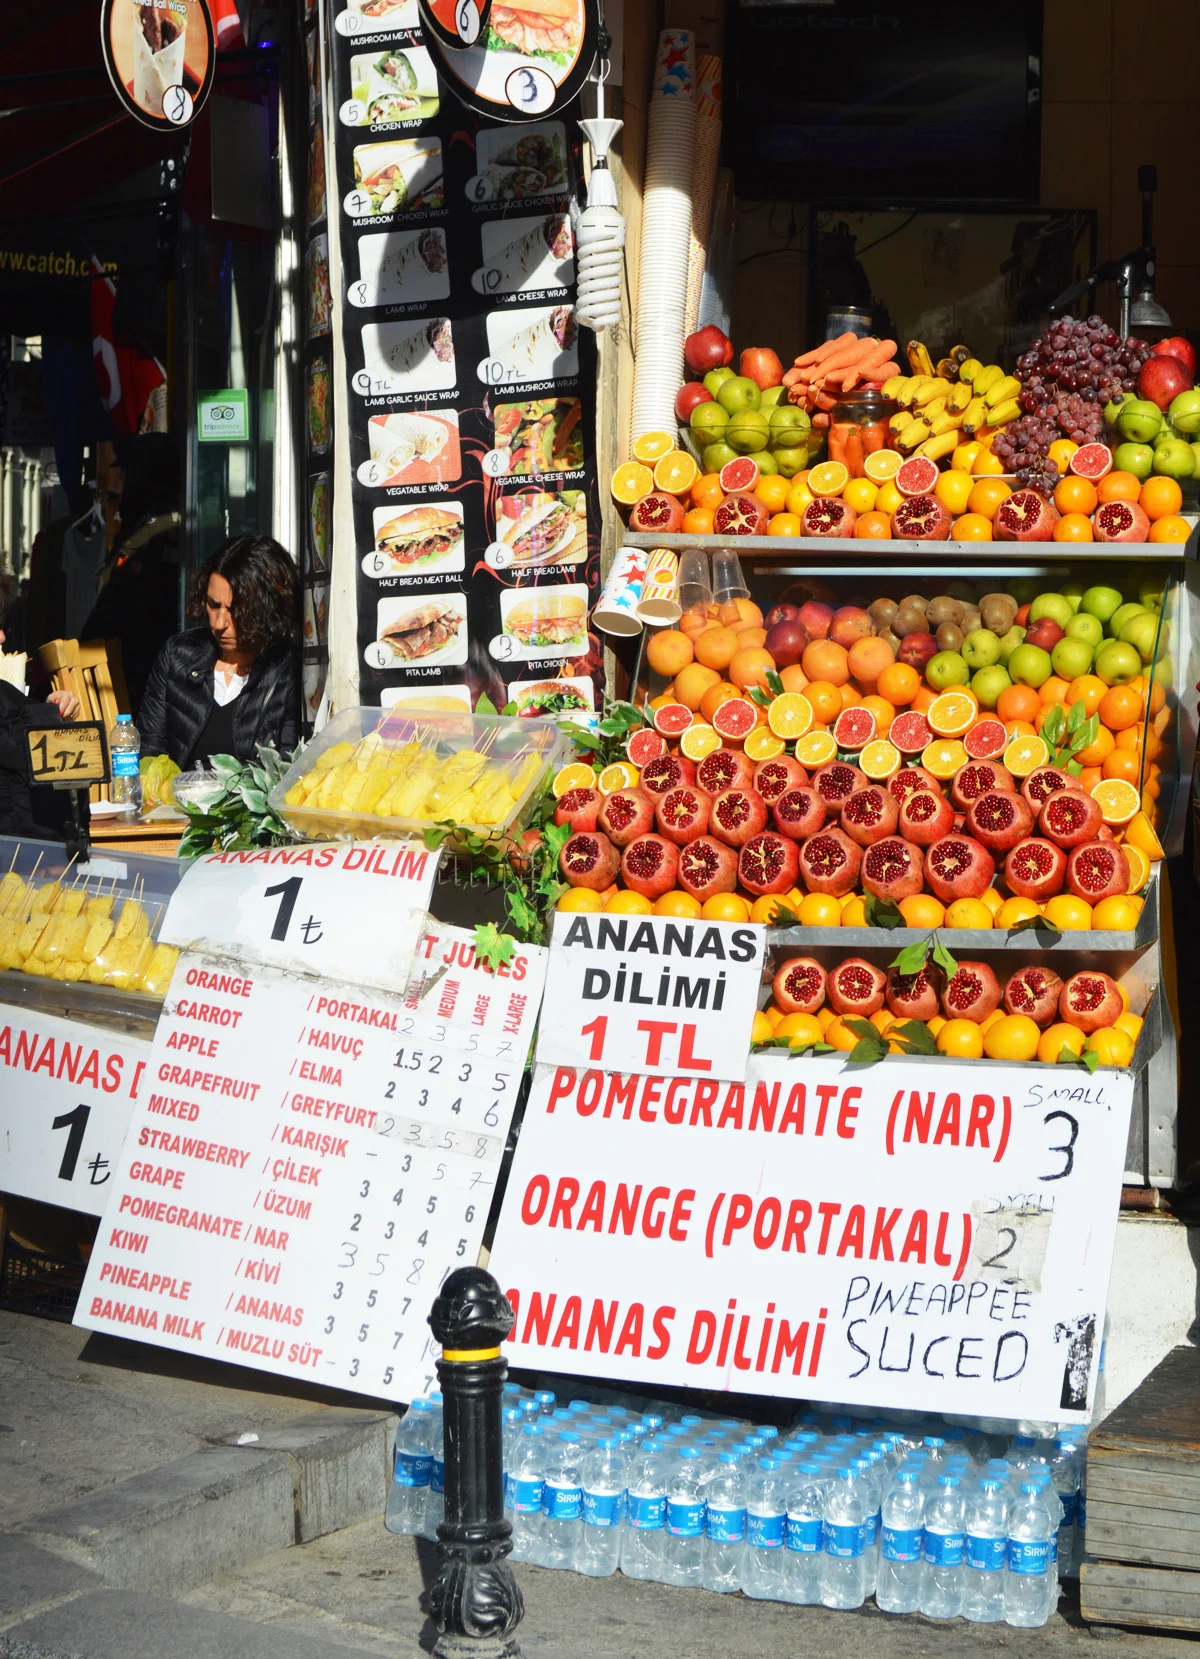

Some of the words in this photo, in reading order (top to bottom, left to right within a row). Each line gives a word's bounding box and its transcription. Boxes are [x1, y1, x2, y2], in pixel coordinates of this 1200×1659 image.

[154, 0, 166, 10] Ball
[168, 1, 186, 14] Wrap
[460, 0, 470, 32] 6
[350, 34, 392, 46] MUSHROOM
[393, 30, 414, 42] MEAT
[518, 69, 538, 102] 3
[172, 86, 186, 121] 8
[348, 105, 358, 122] 5
[370, 121, 402, 132] CHICKEN
[402, 119, 422, 130] WRAP
[474, 178, 485, 200] 6
[351, 194, 367, 212] 7
[472, 201, 498, 214] GARLIC
[500, 200, 522, 210] SAUCE
[524, 196, 554, 208] CHICKEN
[556, 194, 578, 204] WRAP
[352, 215, 394, 227] MUSHROOM
[398, 211, 428, 222] CHICKEN
[429, 208, 450, 218] WRAP
[0, 250, 118, 280] w.catch.cm
[358, 283, 368, 304] 8
[482, 270, 502, 293] 10
[385, 306, 406, 315] LAMB
[407, 304, 428, 312] WRAP
[496, 292, 516, 303] LAMB
[518, 290, 546, 302] CHEESE
[546, 289, 568, 298] WRAP
[358, 374, 372, 396] 9
[485, 361, 504, 384] 10
[364, 396, 386, 406] LAMB
[386, 394, 414, 406] GARLIC
[414, 392, 438, 403] SAUCE
[438, 390, 460, 400] WRAP
[494, 384, 516, 396] LAMB
[516, 382, 556, 394] MUSHROOM
[556, 379, 578, 388] WRAP
[204, 424, 241, 432] tripadvisor
[370, 464, 378, 482] 6
[492, 454, 498, 472] 8
[386, 486, 427, 496] VEGATABLE
[428, 484, 449, 494] WRAP
[495, 476, 534, 486] VEGATABLE
[536, 473, 563, 484] CHEESE
[564, 470, 586, 480] WRAP
[374, 556, 384, 572] 6
[496, 548, 504, 564] 6
[379, 578, 398, 588] HALF
[400, 576, 422, 586] BREAD
[424, 576, 444, 584] MEAT
[446, 574, 462, 584] BALL
[512, 569, 532, 578] HALF
[534, 567, 558, 576] BREAD
[558, 566, 576, 574] LAMB
[377, 652, 386, 667] 6
[500, 636, 513, 660] 3
[406, 669, 420, 677] PITA
[422, 668, 441, 676] LAMB
[528, 661, 542, 670] PITA
[542, 658, 568, 668] CHICKEN
[32, 735, 56, 776] 1
[117, 756, 138, 764] SIRMA
[205, 846, 337, 868] ANANAS
[342, 844, 429, 882] DİLİM
[264, 876, 304, 942] 1
[563, 916, 758, 963] ANANAS
[186, 968, 253, 998] ORANGE
[316, 996, 398, 1032] PORTAKAL
[405, 980, 425, 1010] SMALL
[438, 979, 460, 1018] MEDIUM
[582, 962, 726, 1011] DİLİMİ
[472, 994, 490, 1026] LARGE
[502, 992, 528, 1035] X-LARGE
[177, 1000, 243, 1028] CARROT
[308, 1028, 364, 1060] HAVUÇ
[428, 1055, 443, 1074] 2
[458, 1063, 472, 1082] 3
[492, 1073, 510, 1092] 5
[580, 1016, 608, 1061] 1
[637, 1020, 712, 1072] TL
[0, 1026, 124, 1093] ANANAS
[166, 1030, 220, 1058] APPLE
[298, 1060, 342, 1086] ELMA
[384, 1081, 396, 1099] 2
[418, 1089, 429, 1106] 3
[452, 1097, 462, 1114] 4
[484, 1100, 500, 1127] 6
[158, 1063, 260, 1102] GRAPEFRUIT
[290, 1093, 378, 1128] GREYFURT
[148, 1094, 200, 1122] MIXED
[280, 1125, 350, 1158] KARIŞIK
[402, 1154, 412, 1172] 3
[546, 1066, 862, 1139] POMEGRANATE
[886, 1090, 1012, 1162] (NAR)
[1037, 1110, 1079, 1182] 3
[52, 1103, 92, 1182] 1
[138, 1127, 250, 1169] STRAWBERRY
[272, 1157, 322, 1186] ÇİLEK
[360, 1180, 370, 1198] 3
[393, 1188, 404, 1206] 4
[426, 1196, 437, 1214] 5
[464, 1204, 475, 1223] 6
[129, 1162, 186, 1190] GRAPE
[264, 1188, 312, 1220] ÜZUM
[350, 1213, 362, 1232] 2
[384, 1222, 395, 1240] 3
[418, 1230, 428, 1248] 4
[456, 1238, 467, 1256] 5
[119, 1194, 242, 1240] POMEGRANATE
[254, 1226, 290, 1251] NAR
[338, 1242, 358, 1268] 3
[369, 1253, 390, 1276] 5
[406, 1258, 425, 1286] 8
[521, 1174, 696, 1242] ORANGE
[705, 1192, 972, 1282] (PORTAKAL)
[981, 1227, 1017, 1269] 2
[109, 1228, 149, 1254] KIWI
[244, 1258, 282, 1284] KİVİ
[333, 1282, 344, 1300] 3
[366, 1289, 378, 1308] 5
[402, 1297, 412, 1316] 7
[100, 1262, 192, 1300] PINEAPPLE
[234, 1294, 304, 1326] ANANAS
[324, 1316, 335, 1334] 3
[358, 1324, 369, 1342] 5
[393, 1332, 404, 1350] 7
[90, 1297, 158, 1330] BANANA
[162, 1314, 206, 1340] MILK
[226, 1328, 284, 1359] MUZLU
[288, 1342, 322, 1368] SÜT
[349, 1358, 360, 1376] 3
[383, 1366, 394, 1384] 5
[424, 1375, 434, 1394] 7
[502, 1288, 676, 1360] ANANAS
[686, 1298, 828, 1378] DİLİMİ
